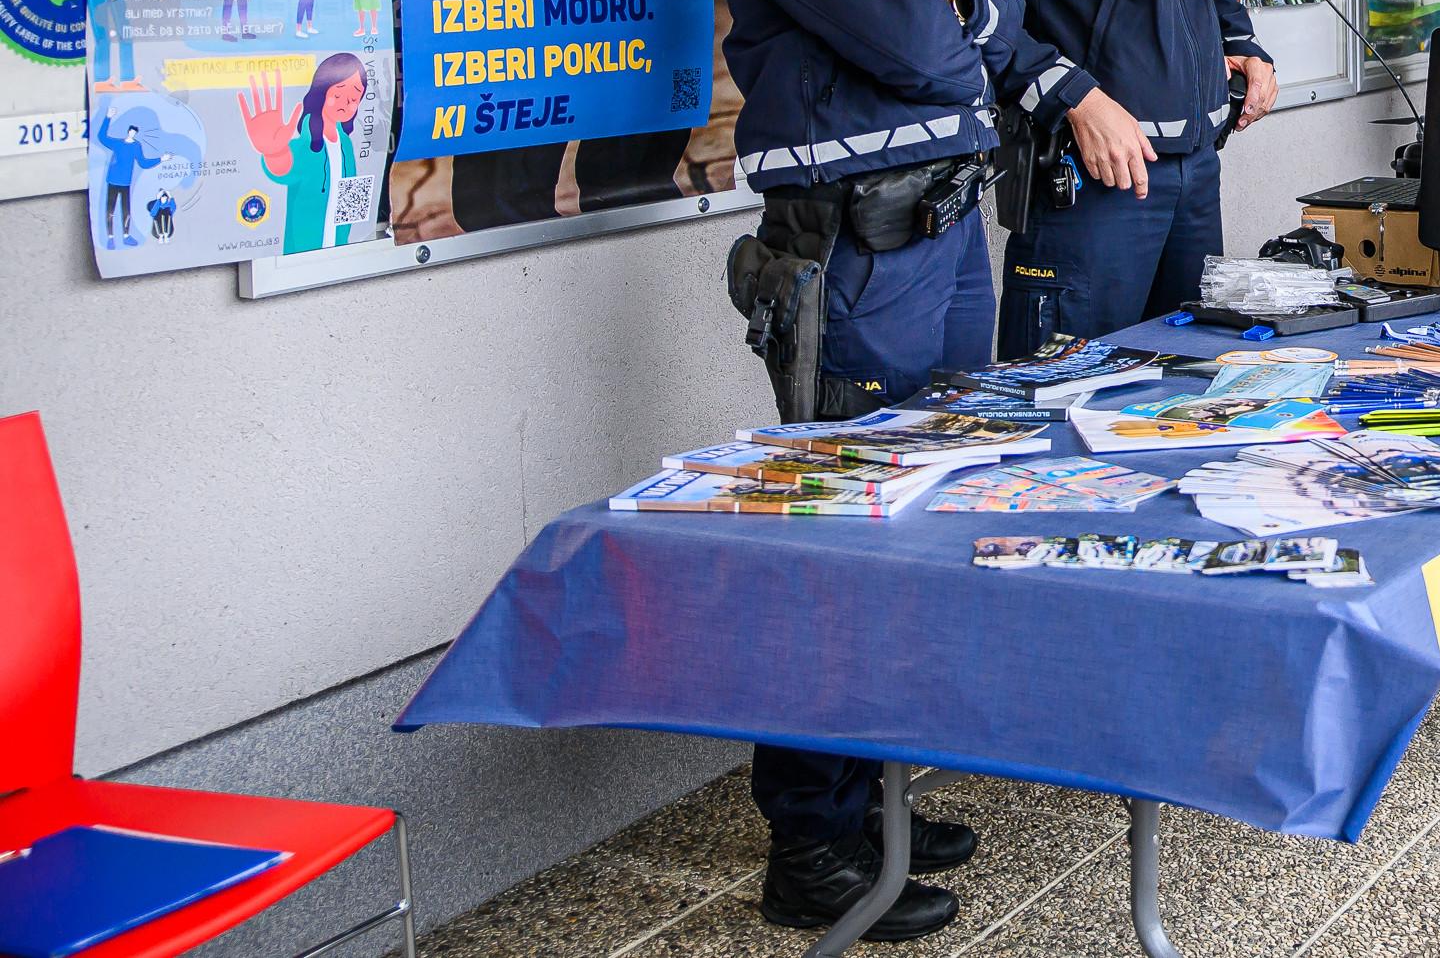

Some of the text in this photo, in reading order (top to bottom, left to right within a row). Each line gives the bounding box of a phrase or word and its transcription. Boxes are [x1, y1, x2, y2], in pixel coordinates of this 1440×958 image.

[42, 38, 55, 49] OF
[56, 40, 74, 51] THE
[433, 38, 653, 87] IZBERI POKLIC,
[431, 92, 576, 139] KI ŠTEJE.
[18, 121, 69, 145] 2013
[161, 159, 237, 172] NASILJE SE LAHKO
[157, 170, 189, 181] DOGAJA
[192, 169, 212, 178] TUDI
[1015, 265, 1055, 278] POLICIJA
[1388, 266, 1427, 280] alpina
[979, 382, 1026, 396] SLOVENSKA POLICIJA
[977, 410, 1008, 418] POLICIJA
